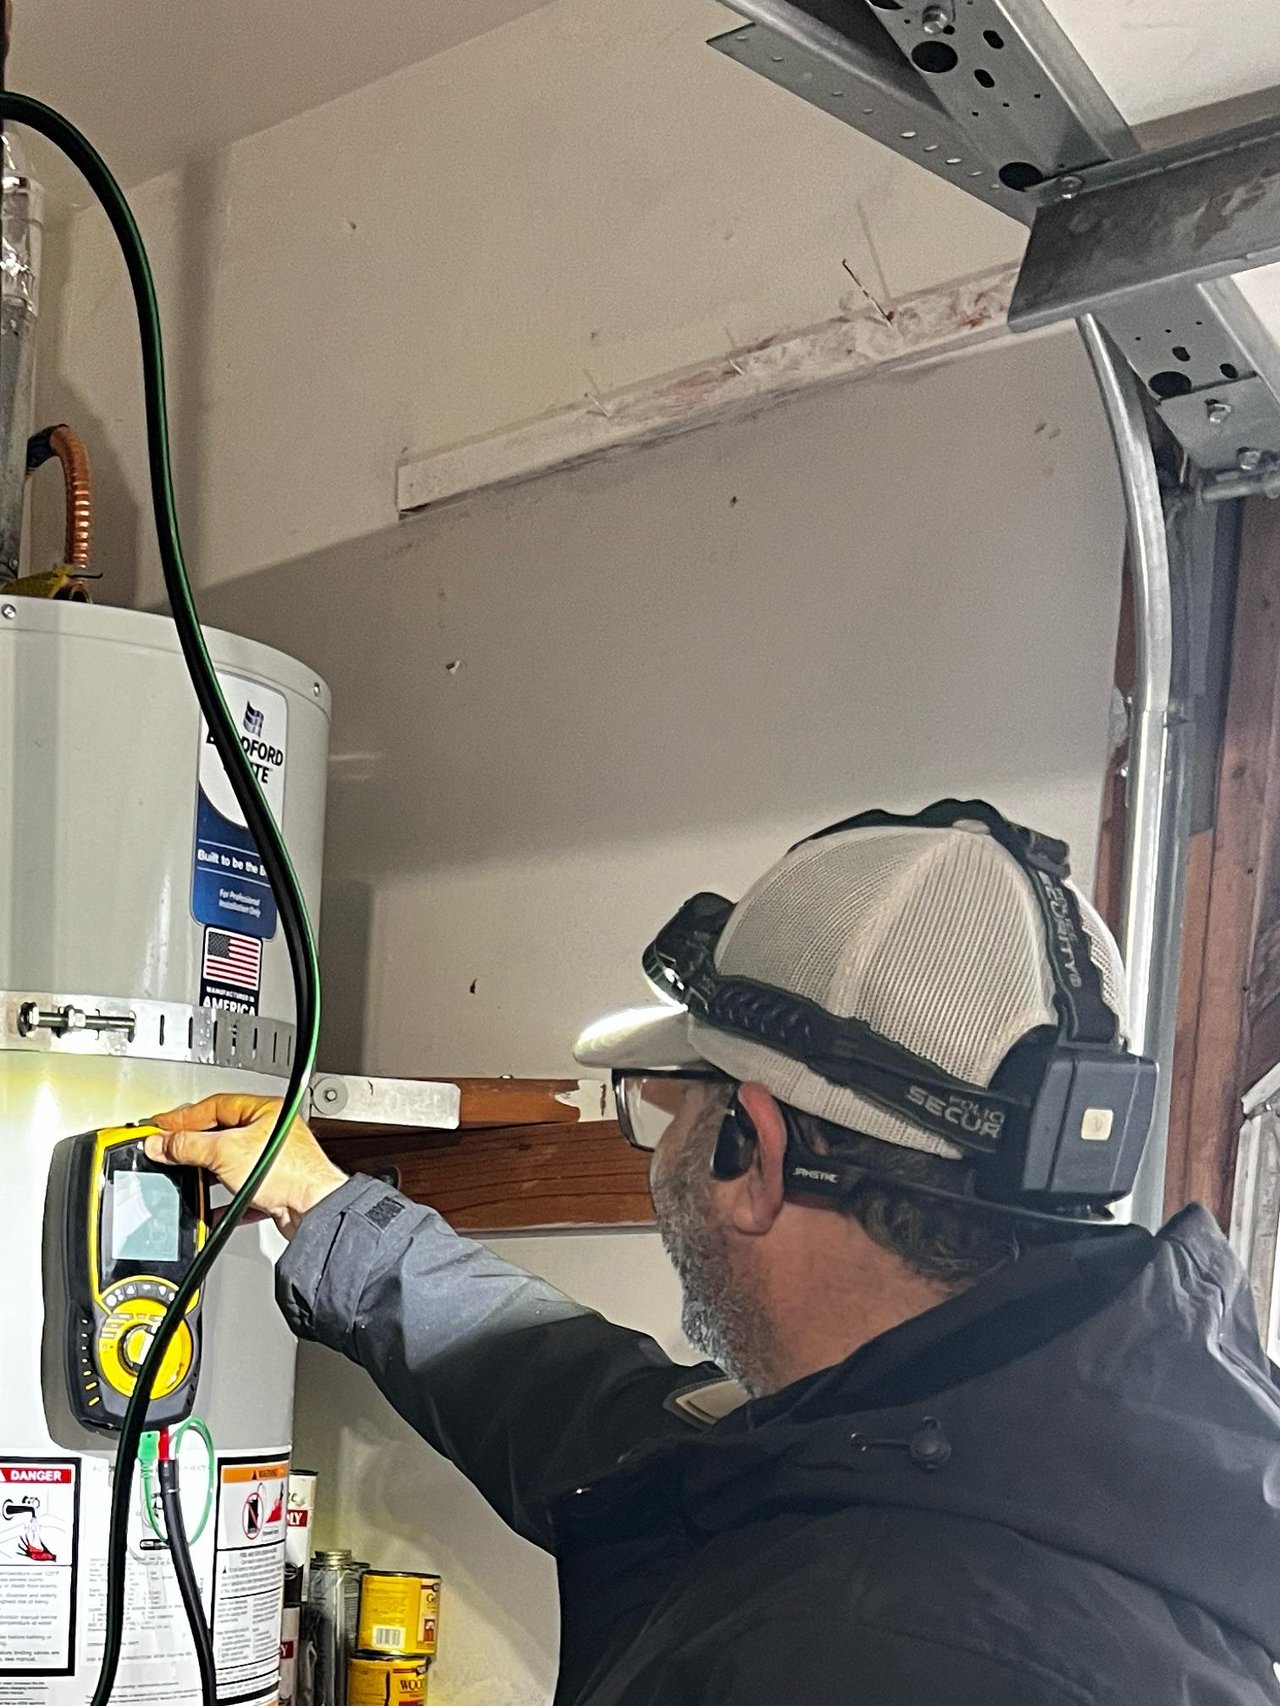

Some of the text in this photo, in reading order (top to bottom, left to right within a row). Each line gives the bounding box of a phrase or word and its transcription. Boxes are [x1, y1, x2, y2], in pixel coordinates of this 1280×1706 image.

[198, 849, 219, 864] Built
[221, 855, 230, 866] to
[232, 857, 243, 870] be
[245, 861, 258, 874] the
[203, 996, 255, 1015] AMERICA
[906, 1085, 1002, 1138] SECUR
[10, 1470, 62, 1481] DANGER
